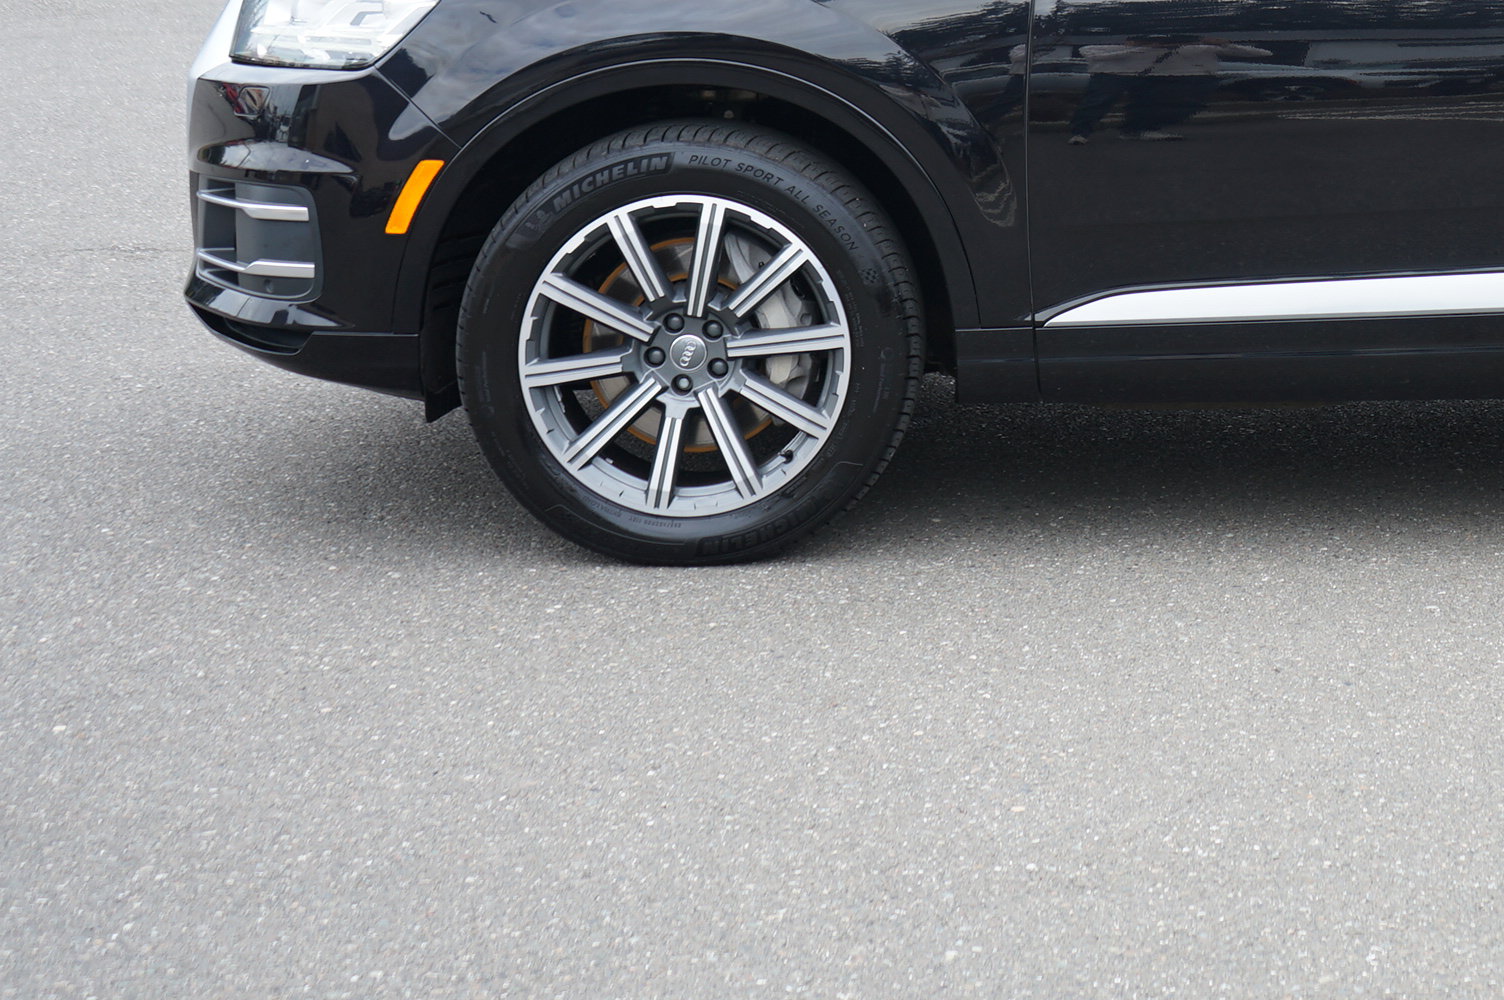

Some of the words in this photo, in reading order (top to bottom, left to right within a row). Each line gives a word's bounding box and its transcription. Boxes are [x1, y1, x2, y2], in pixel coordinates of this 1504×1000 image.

[553, 156, 668, 212] MICHELIN
[688, 154, 732, 169] PILOT
[735, 162, 784, 186] SPORT
[784, 185, 809, 206] ALL
[812, 203, 860, 252] SEASON
